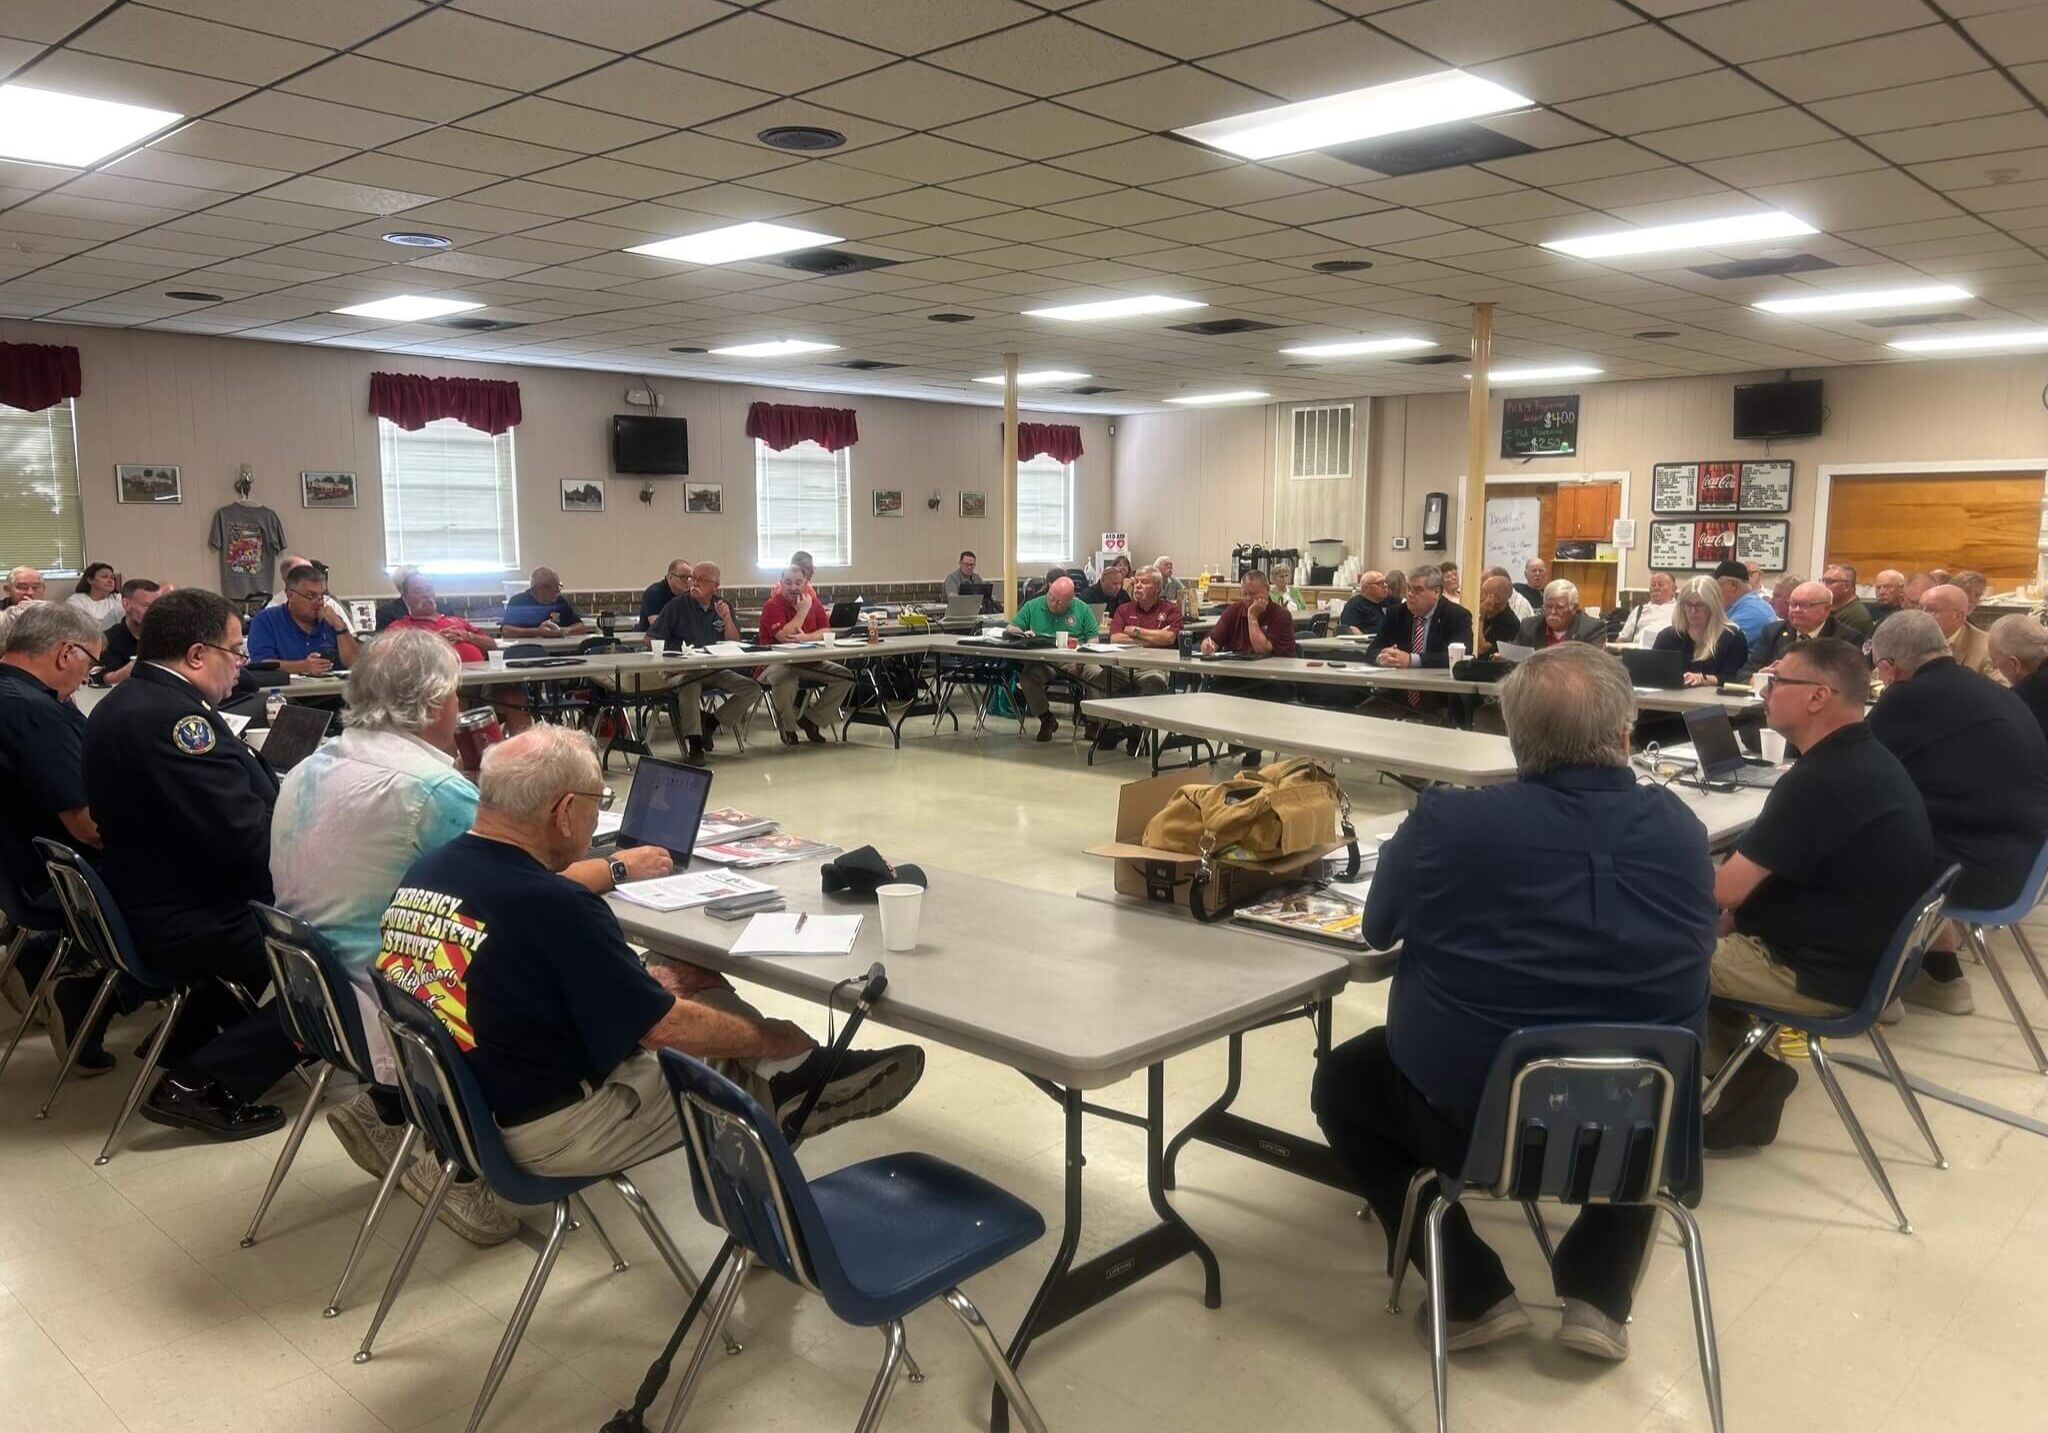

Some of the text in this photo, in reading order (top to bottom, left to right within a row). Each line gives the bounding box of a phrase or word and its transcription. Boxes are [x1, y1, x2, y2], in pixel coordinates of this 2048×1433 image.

[1544, 410, 1575, 428] $400
[382, 930, 441, 961] STITUTE
[421, 913, 488, 951] SAFETY
[390, 962, 458, 994] Highway
